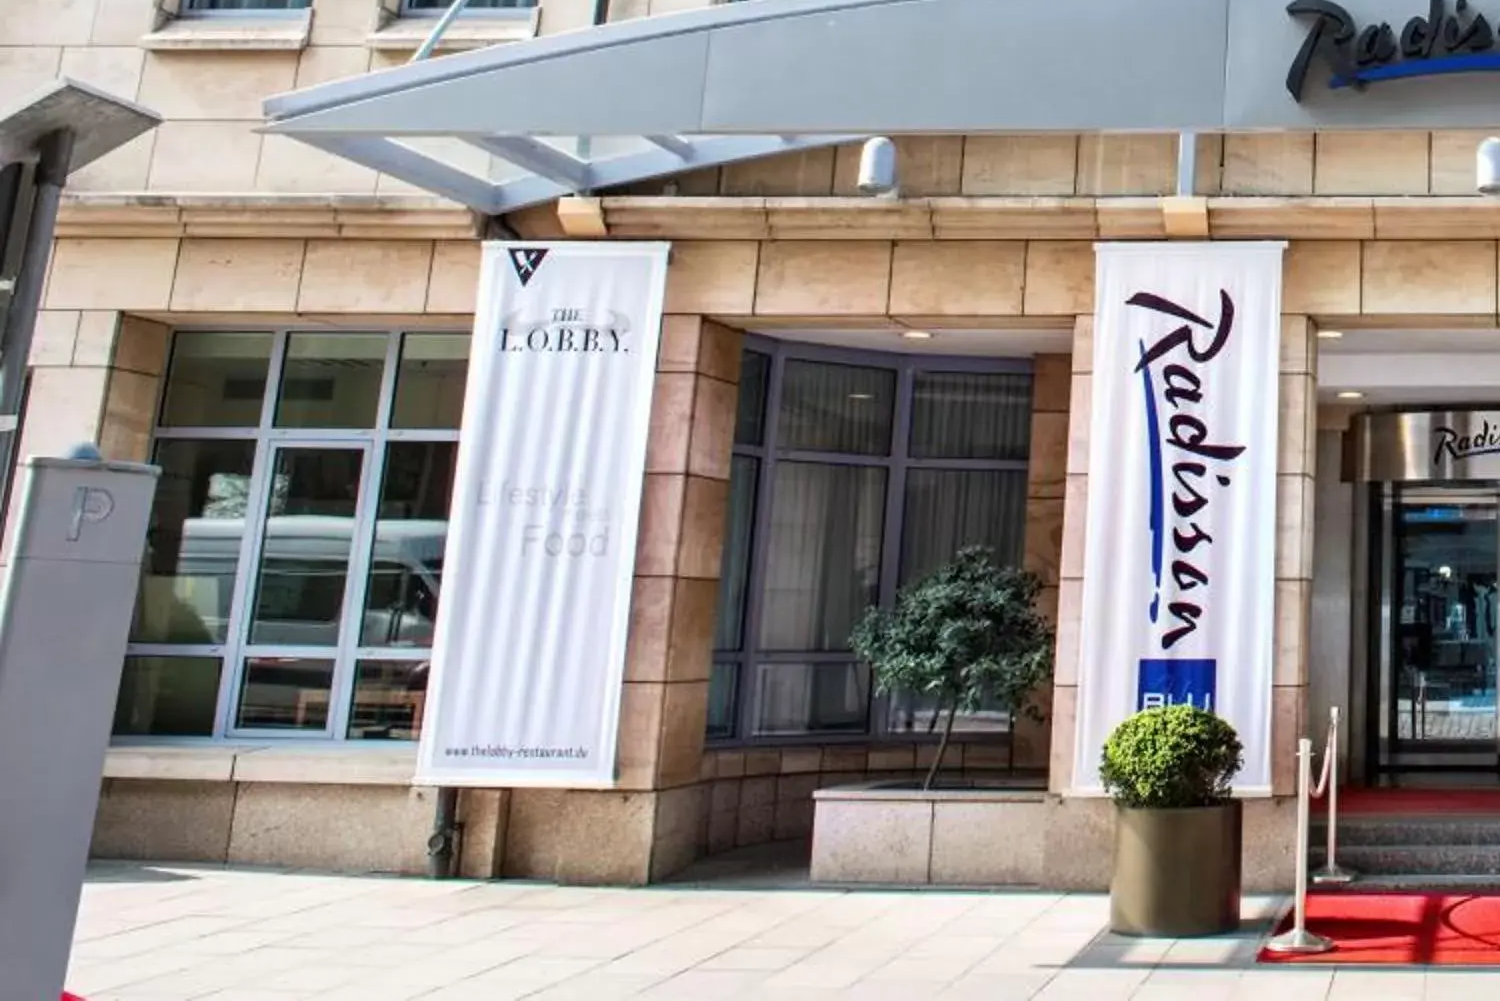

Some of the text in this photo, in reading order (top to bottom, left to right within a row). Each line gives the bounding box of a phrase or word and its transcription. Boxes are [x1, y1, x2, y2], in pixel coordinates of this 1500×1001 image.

[552, 308, 584, 322] THE
[501, 326, 630, 353] L.O.B.B.Y.
[1125, 288, 1247, 650] Radisson
[66, 486, 115, 542] P
[521, 524, 610, 557] Food
